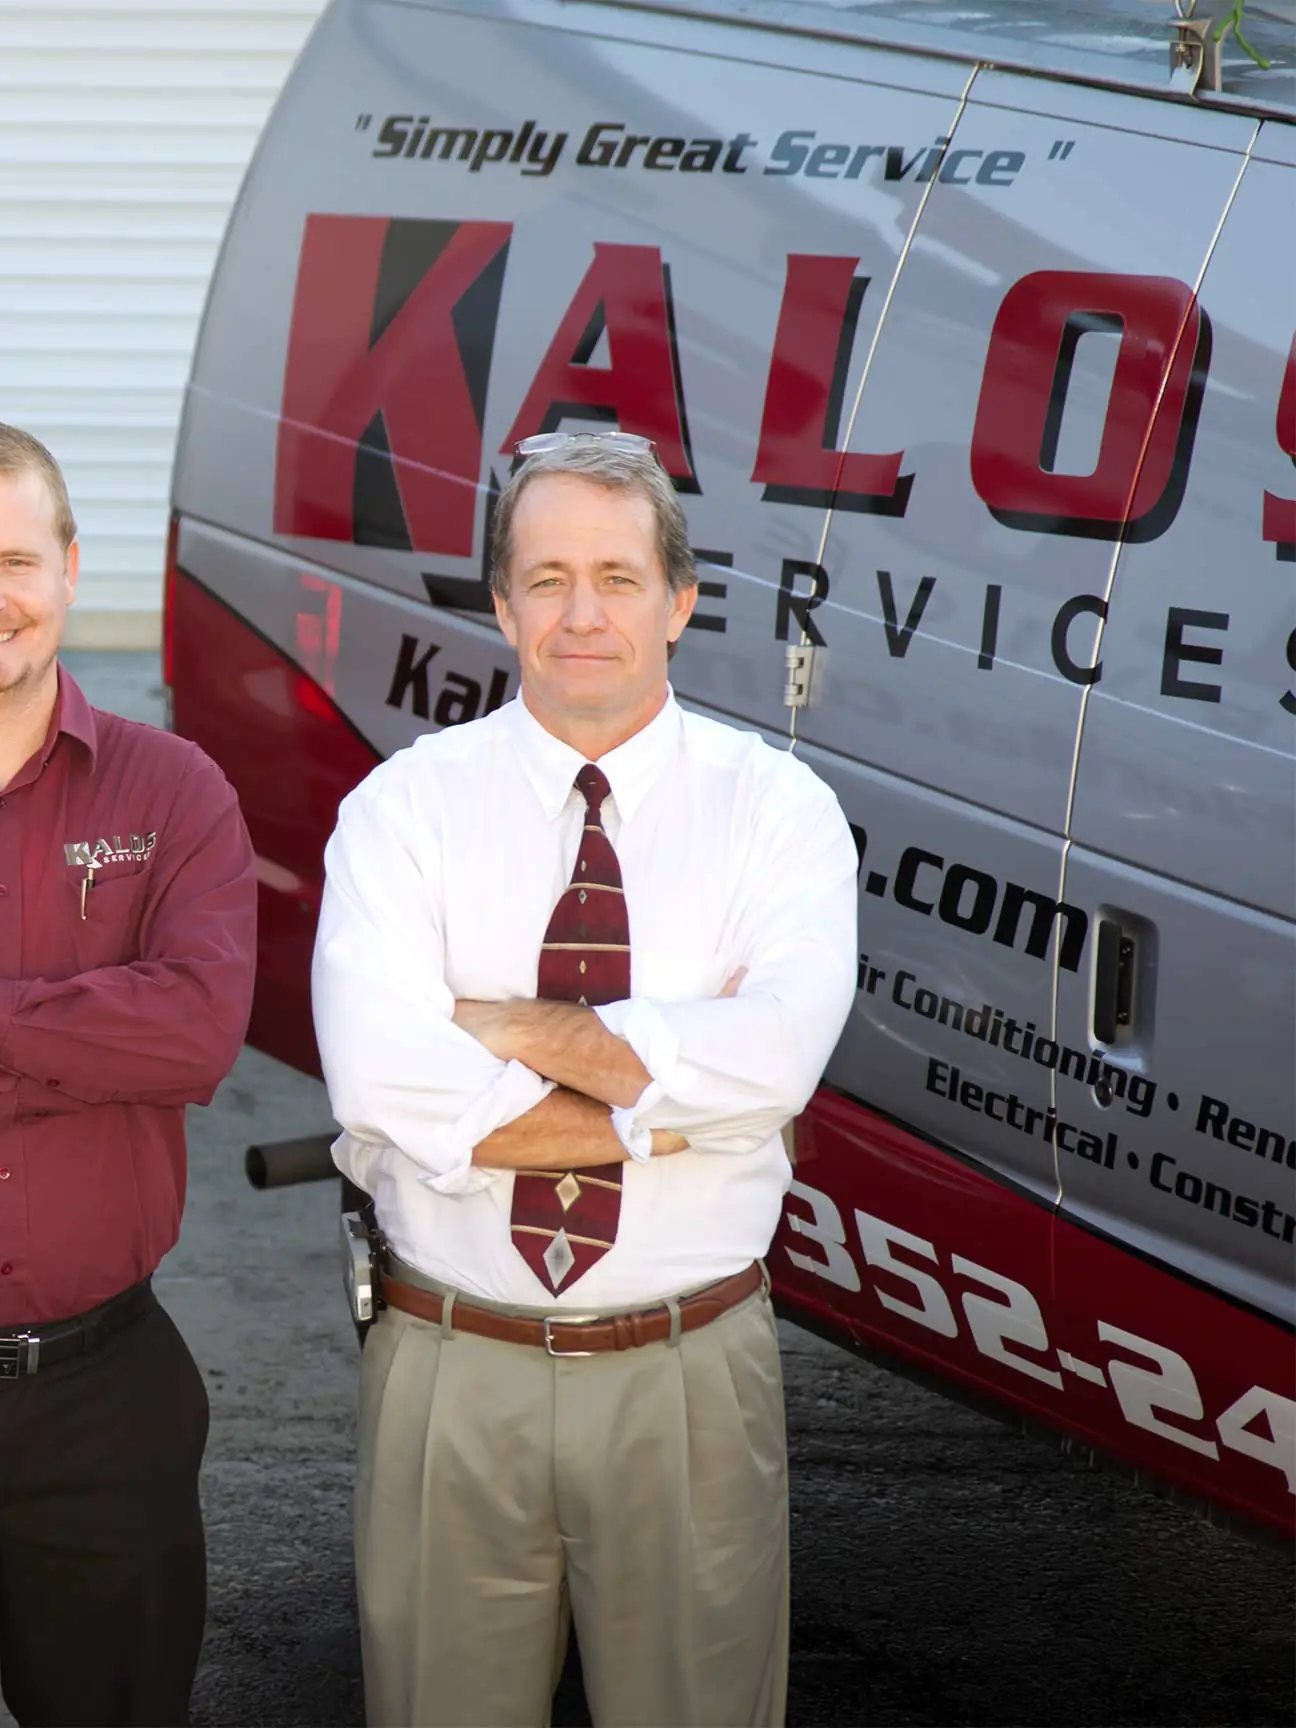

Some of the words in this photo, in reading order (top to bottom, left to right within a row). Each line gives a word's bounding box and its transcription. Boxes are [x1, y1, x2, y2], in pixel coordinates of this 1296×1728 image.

[575, 123, 757, 173] Great
[273, 213, 1296, 612] KALO
[385, 633, 517, 727] Kal
[64, 832, 156, 869] KALOS
[103, 852, 151, 863] SERVICE
[857, 953, 886, 994] ir
[892, 969, 1157, 1118] Conditioning
[925, 1057, 1118, 1169] Electrical
